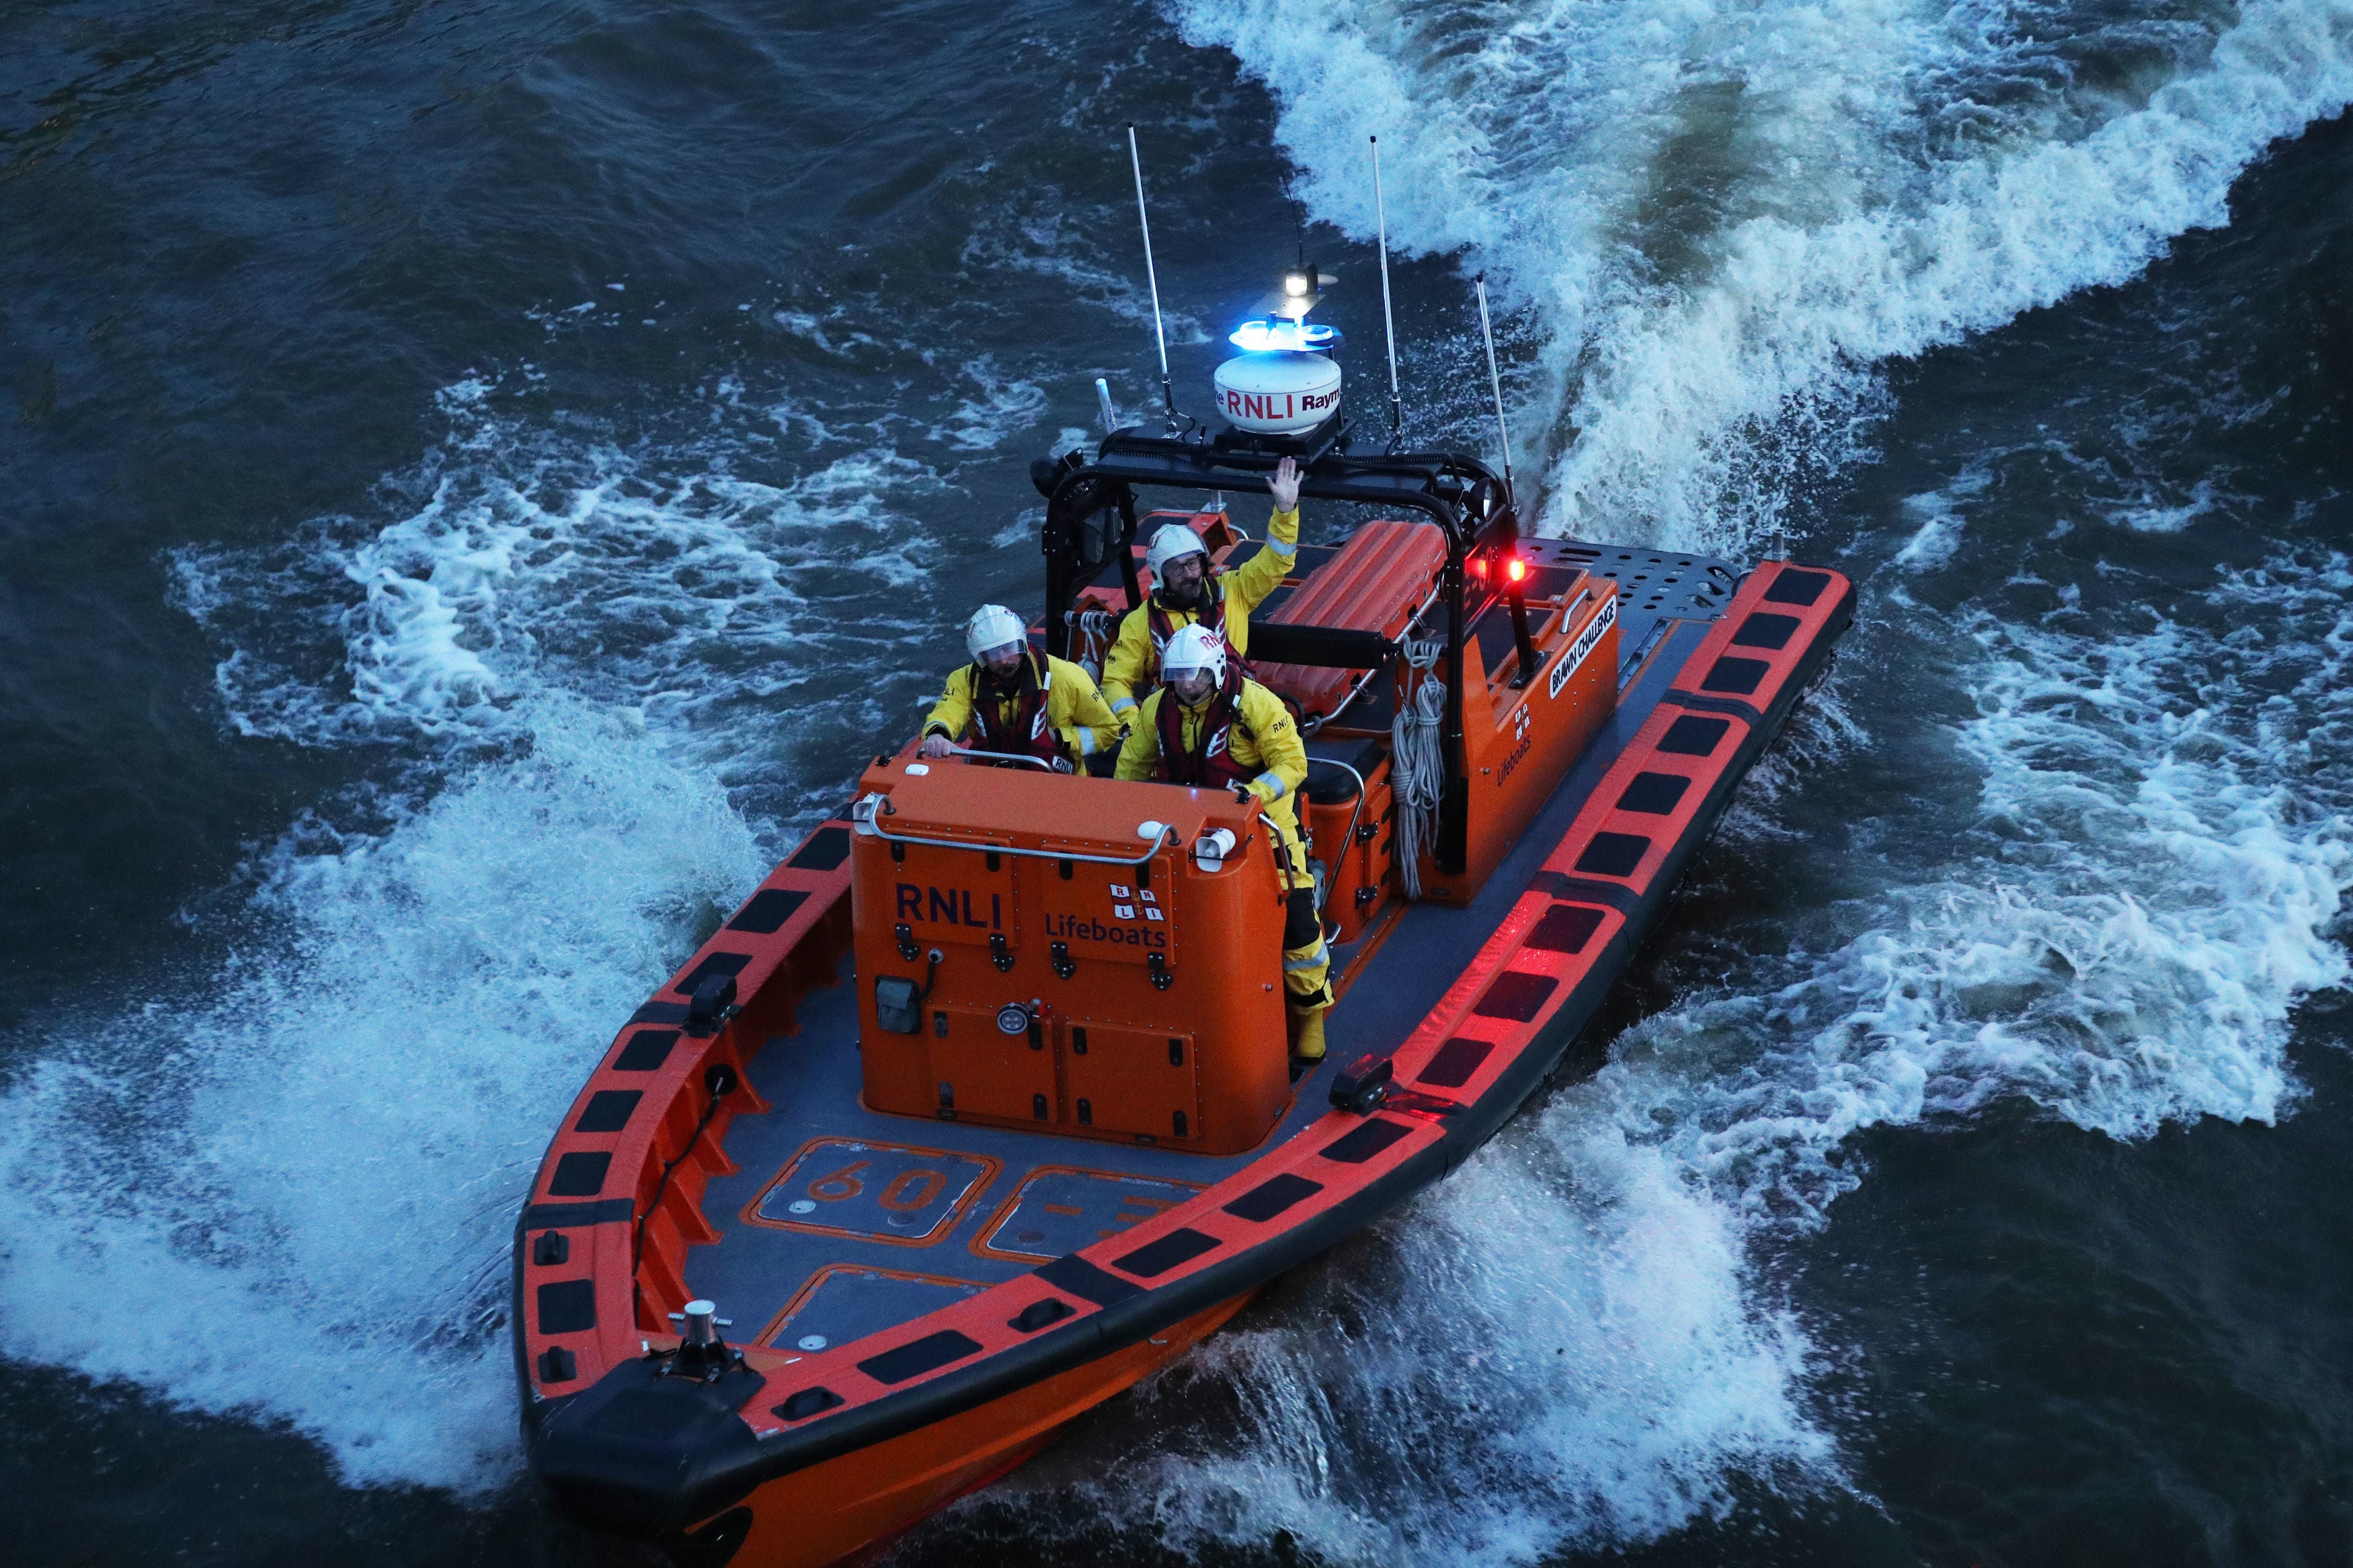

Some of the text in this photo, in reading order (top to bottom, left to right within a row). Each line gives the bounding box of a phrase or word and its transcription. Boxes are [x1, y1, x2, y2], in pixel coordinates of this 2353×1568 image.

[1227, 390, 1293, 419] RNLI
[1552, 601, 1614, 693] BRAWN CHALLENGE
[1272, 714, 1289, 733] RNLI
[1497, 735, 1531, 787] Lifeboats
[896, 882, 1001, 930] RNLI
[1045, 913, 1166, 948] Lifeboats
